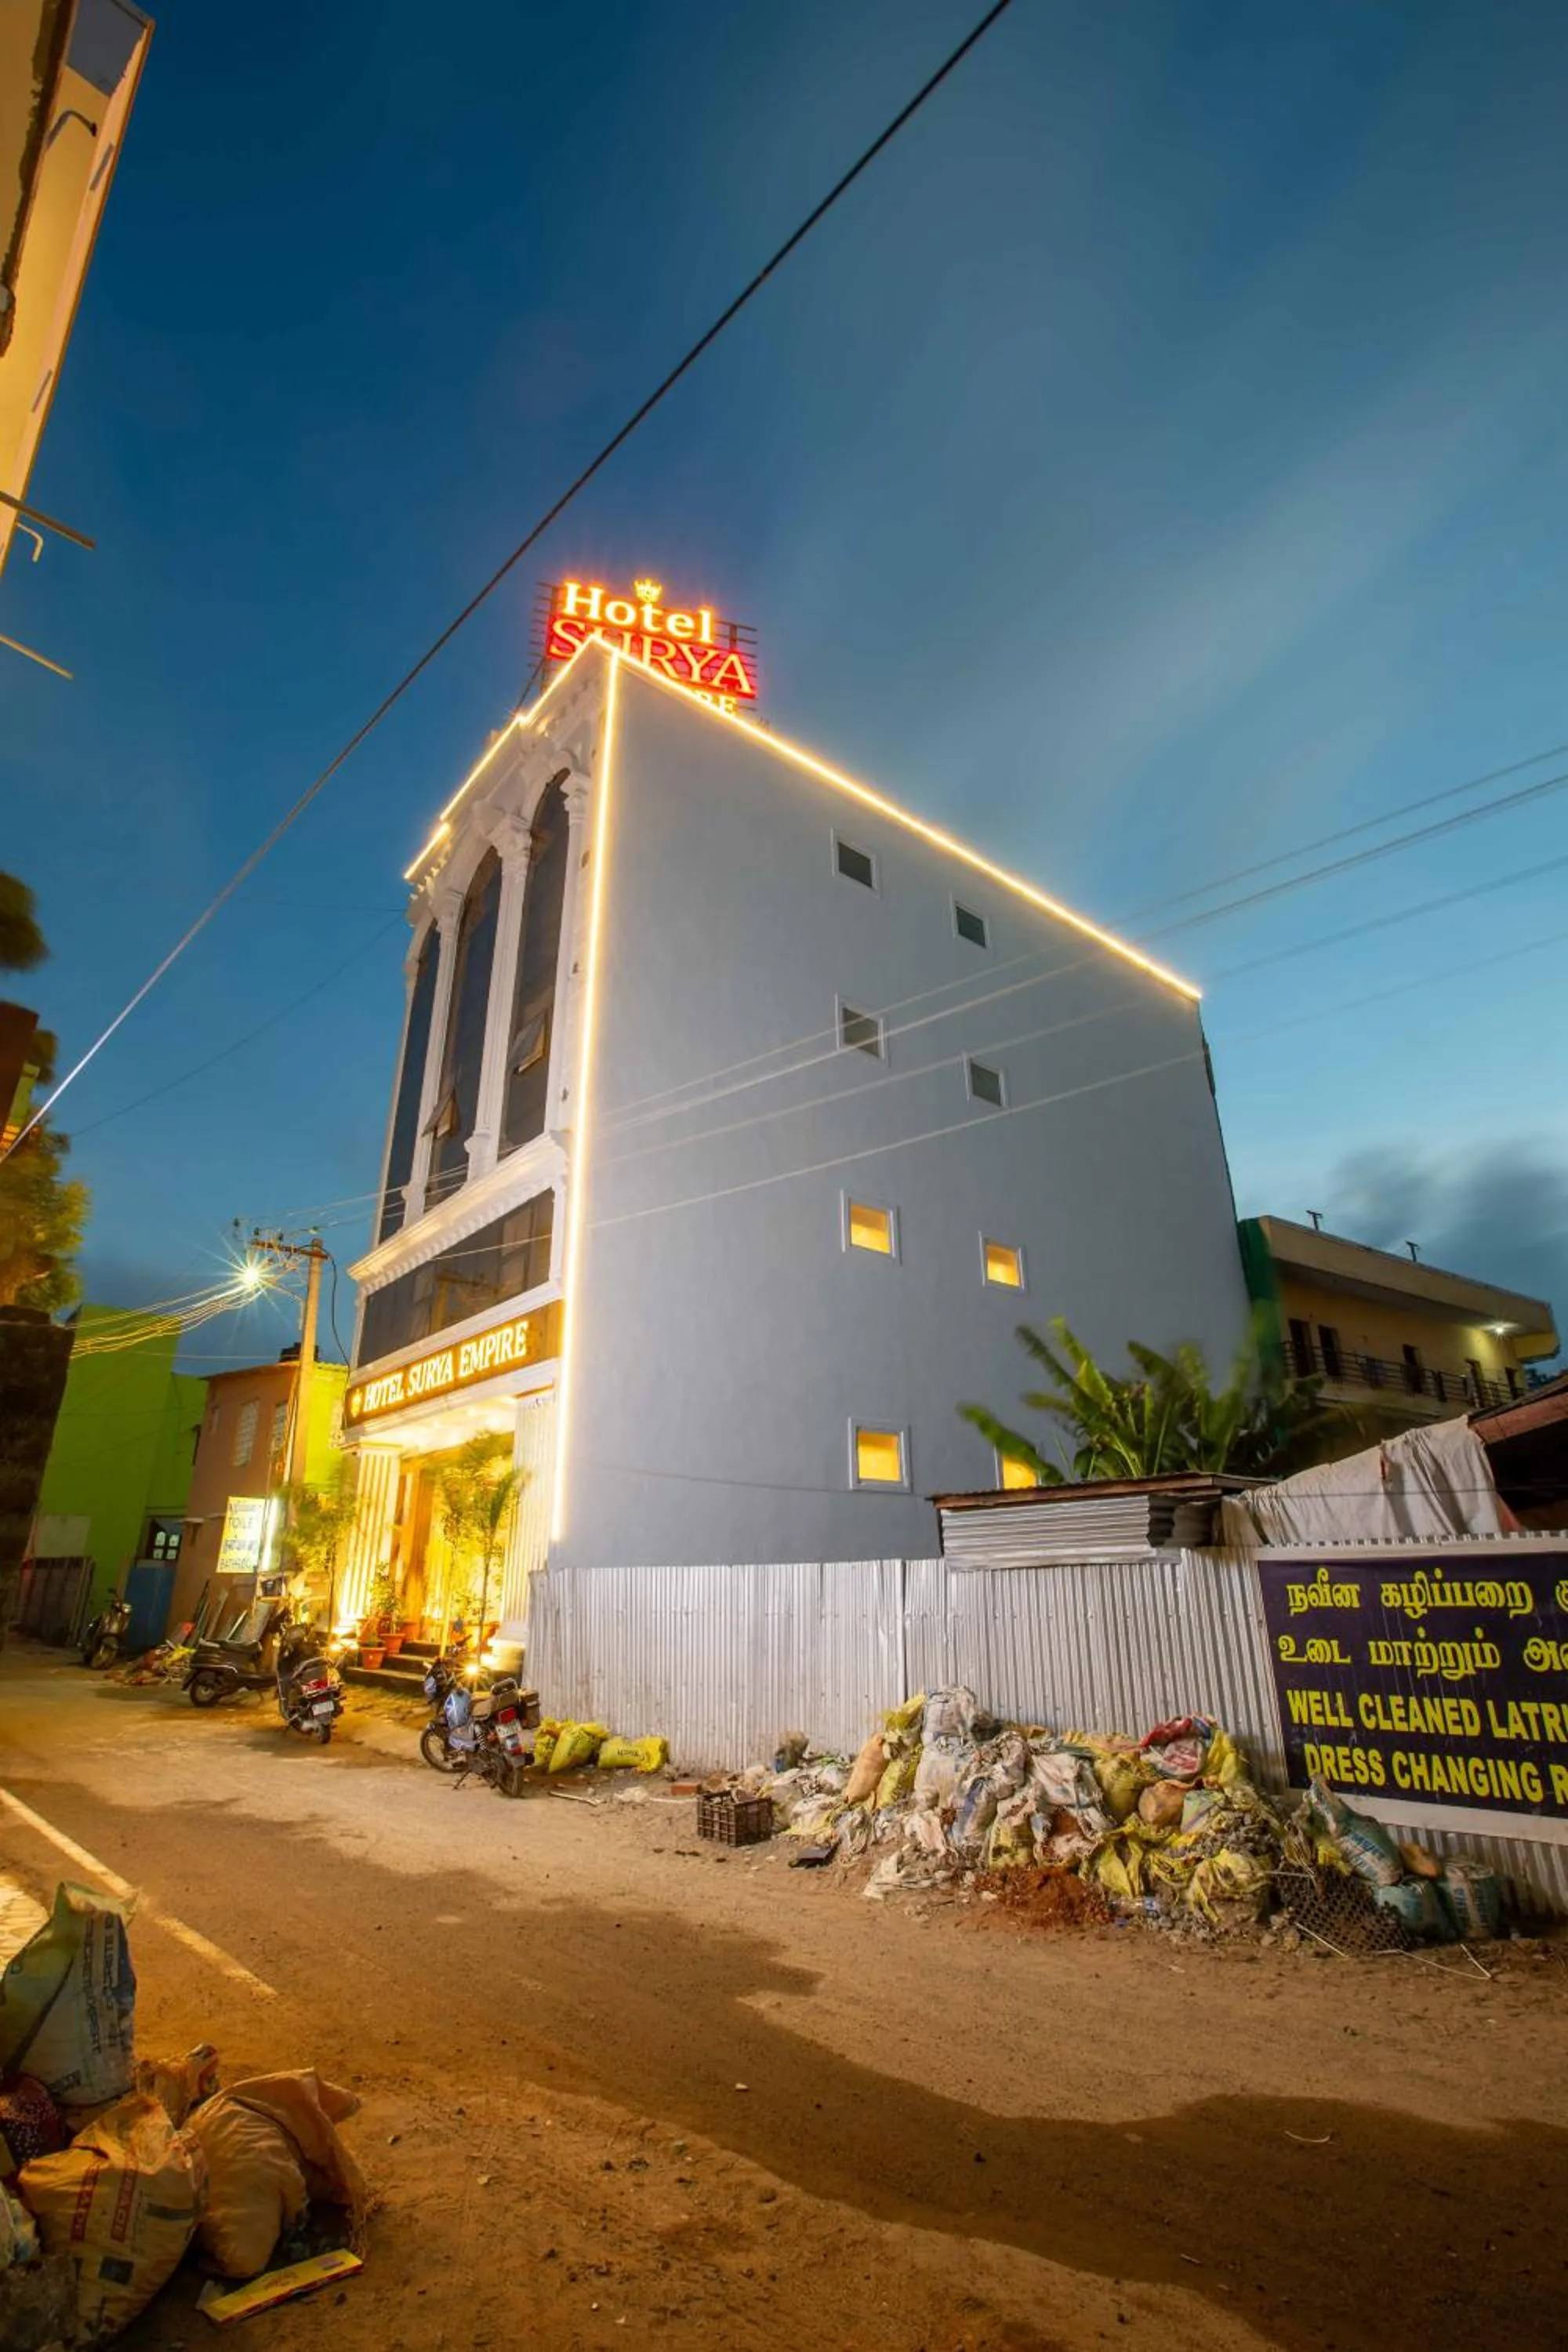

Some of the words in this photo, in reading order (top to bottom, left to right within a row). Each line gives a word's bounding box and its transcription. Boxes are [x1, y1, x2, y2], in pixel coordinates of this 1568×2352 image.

[561, 582, 714, 644] Hotel
[363, 1374, 405, 1412] HOTEL
[407, 1351, 453, 1396] SURYA
[457, 1320, 529, 1379] EMPIRE
[1286, 1568, 1361, 1615] நவீன
[1381, 1568, 1534, 1619] கழிப்பறை
[1279, 1635, 1352, 1664] உடை
[1367, 1627, 1501, 1680] மாற்றும்
[1287, 1690, 1354, 1728] WELL
[1358, 1693, 1481, 1737] CLEANED
[1304, 1743, 1386, 1786] DRESS
[1392, 1751, 1544, 1803] CHANGING
